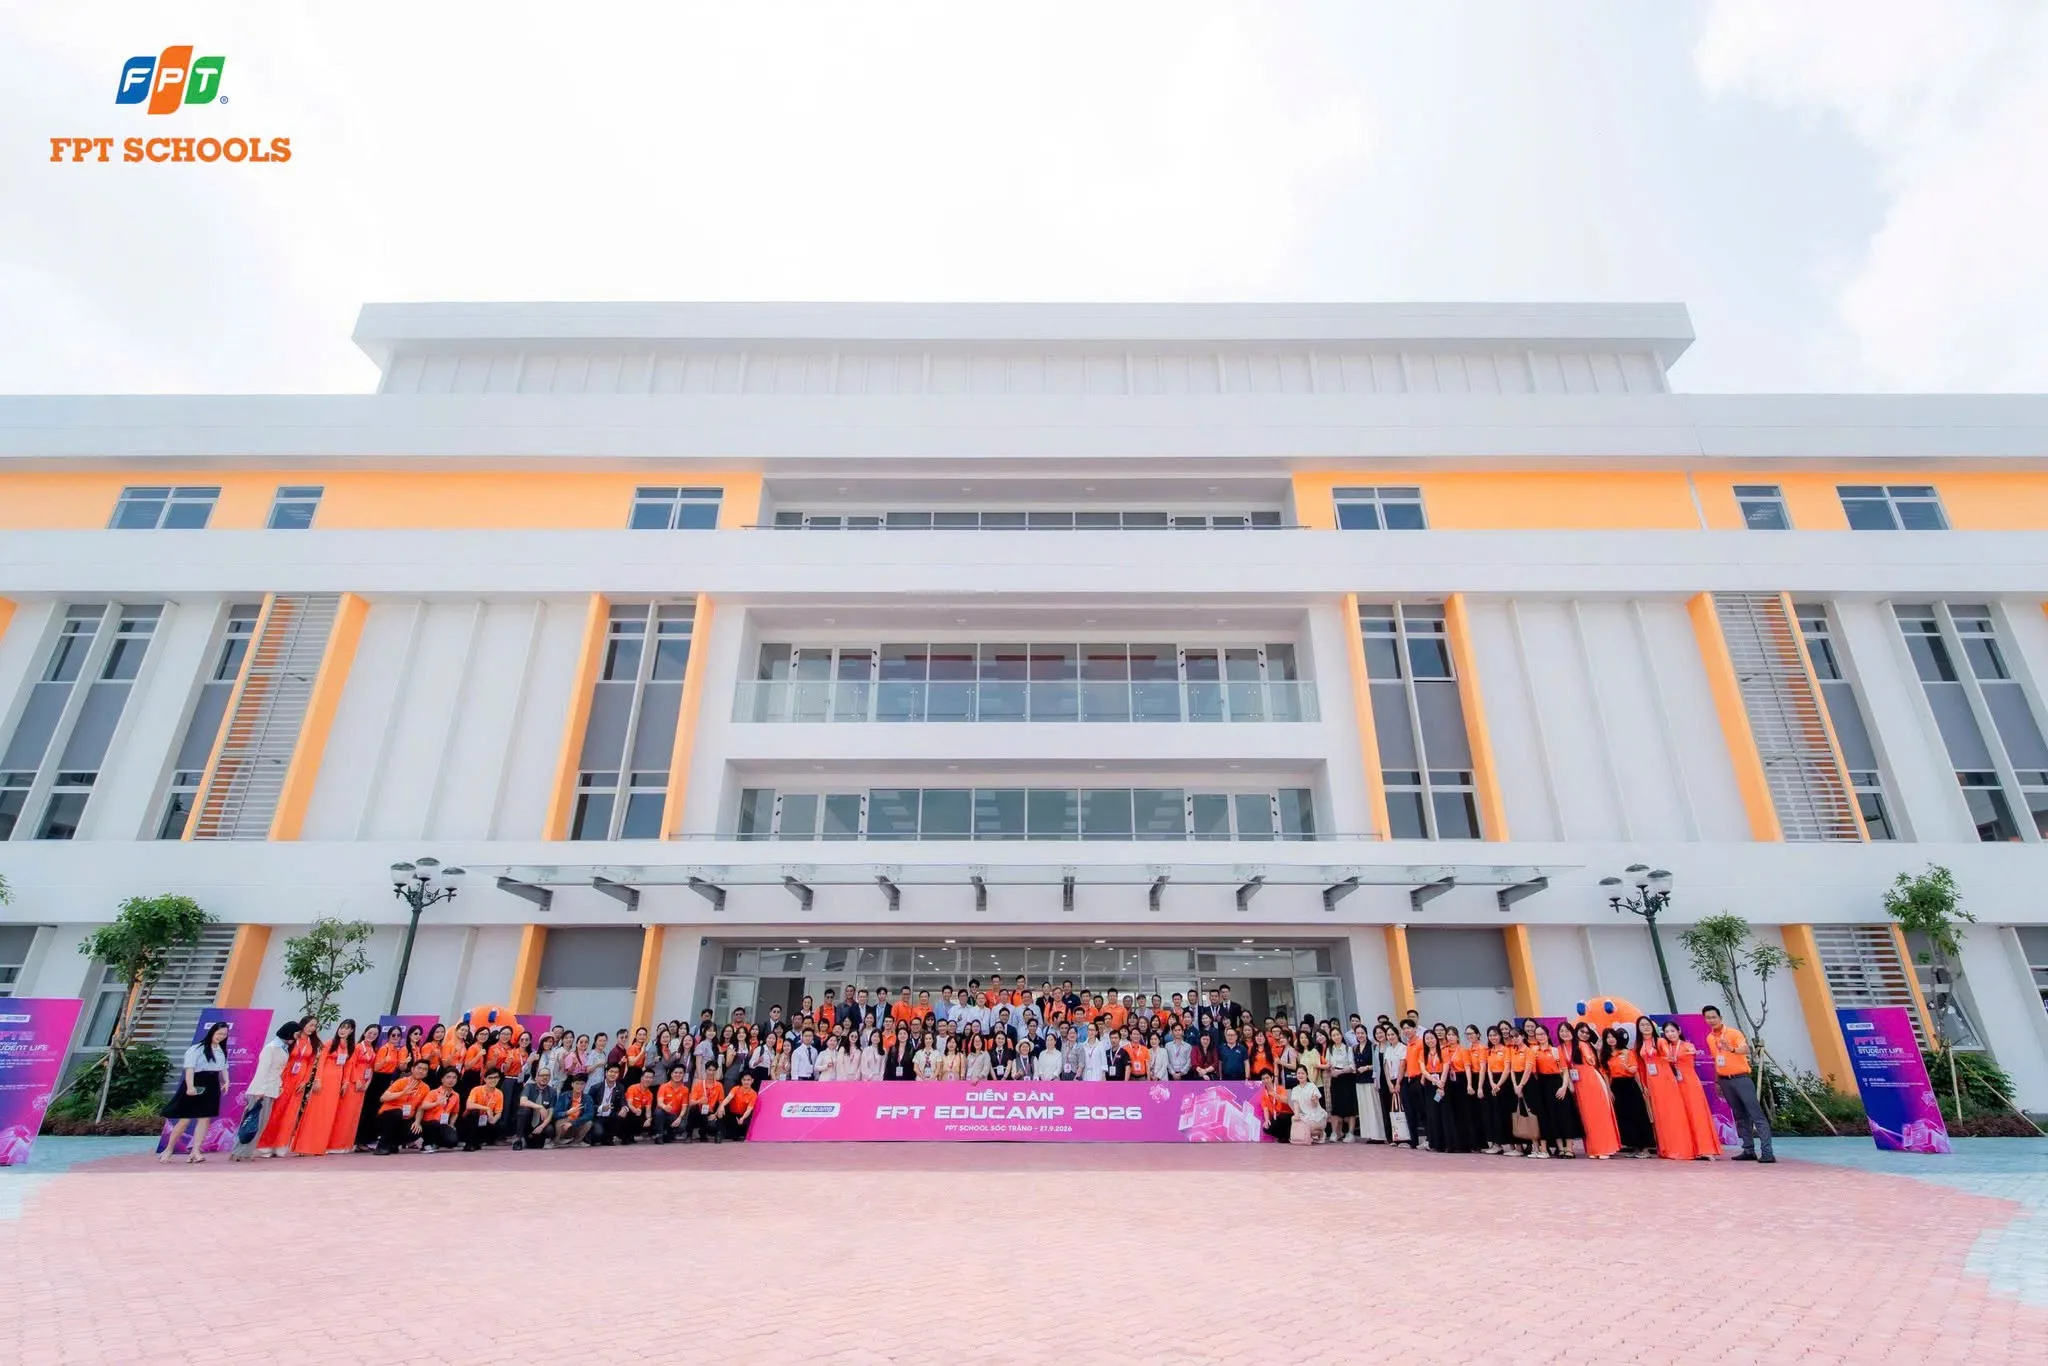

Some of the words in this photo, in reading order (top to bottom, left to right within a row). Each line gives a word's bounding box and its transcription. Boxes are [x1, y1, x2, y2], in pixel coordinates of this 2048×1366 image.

[1013, 1090, 1054, 1102] ĐÀN
[876, 1105, 926, 1119] FPT
[934, 1105, 1064, 1120] EDUCAMP
[1073, 1106, 1143, 1120] 2026
[944, 1124, 958, 1132] FPT
[959, 1124, 989, 1132] SCHOOL
